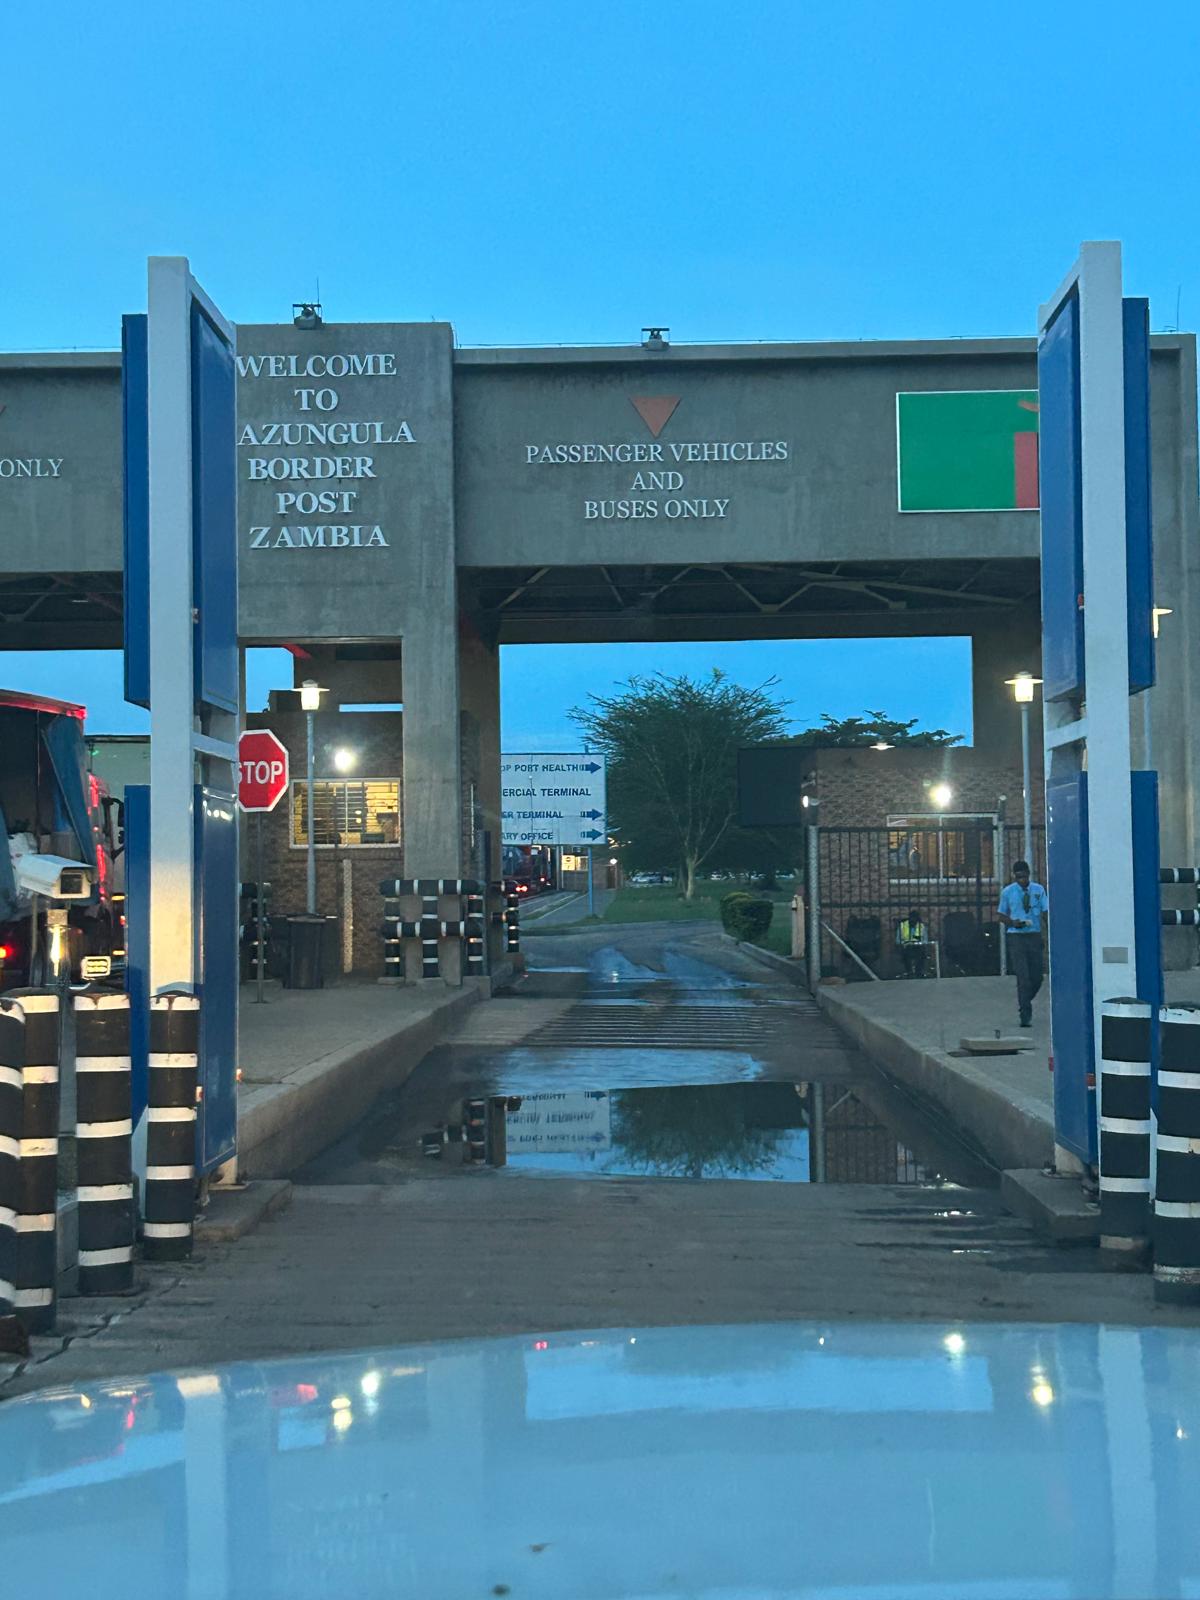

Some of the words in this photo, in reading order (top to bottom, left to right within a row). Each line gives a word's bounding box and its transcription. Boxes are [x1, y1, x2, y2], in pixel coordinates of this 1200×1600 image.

[236, 354, 397, 378] WELCOME
[294, 388, 339, 411] TO
[237, 421, 416, 446] AZUNGULA
[525, 444, 664, 463] PASSENGER
[669, 442, 788, 462] VEHICLES
[0, 458, 64, 478] ONLY
[248, 456, 377, 481] BORDER
[630, 471, 684, 490] AND
[276, 491, 357, 515] POST
[584, 500, 659, 519] BUSES
[664, 499, 730, 518] ONLY
[249, 525, 391, 549] ZAMBIA
[514, 764, 539, 772] PORT
[542, 764, 580, 772] HEALTH
[540, 788, 591, 797] TERMINAL
[516, 811, 564, 819] TERMINAL
[520, 832, 553, 841] OFFICE
